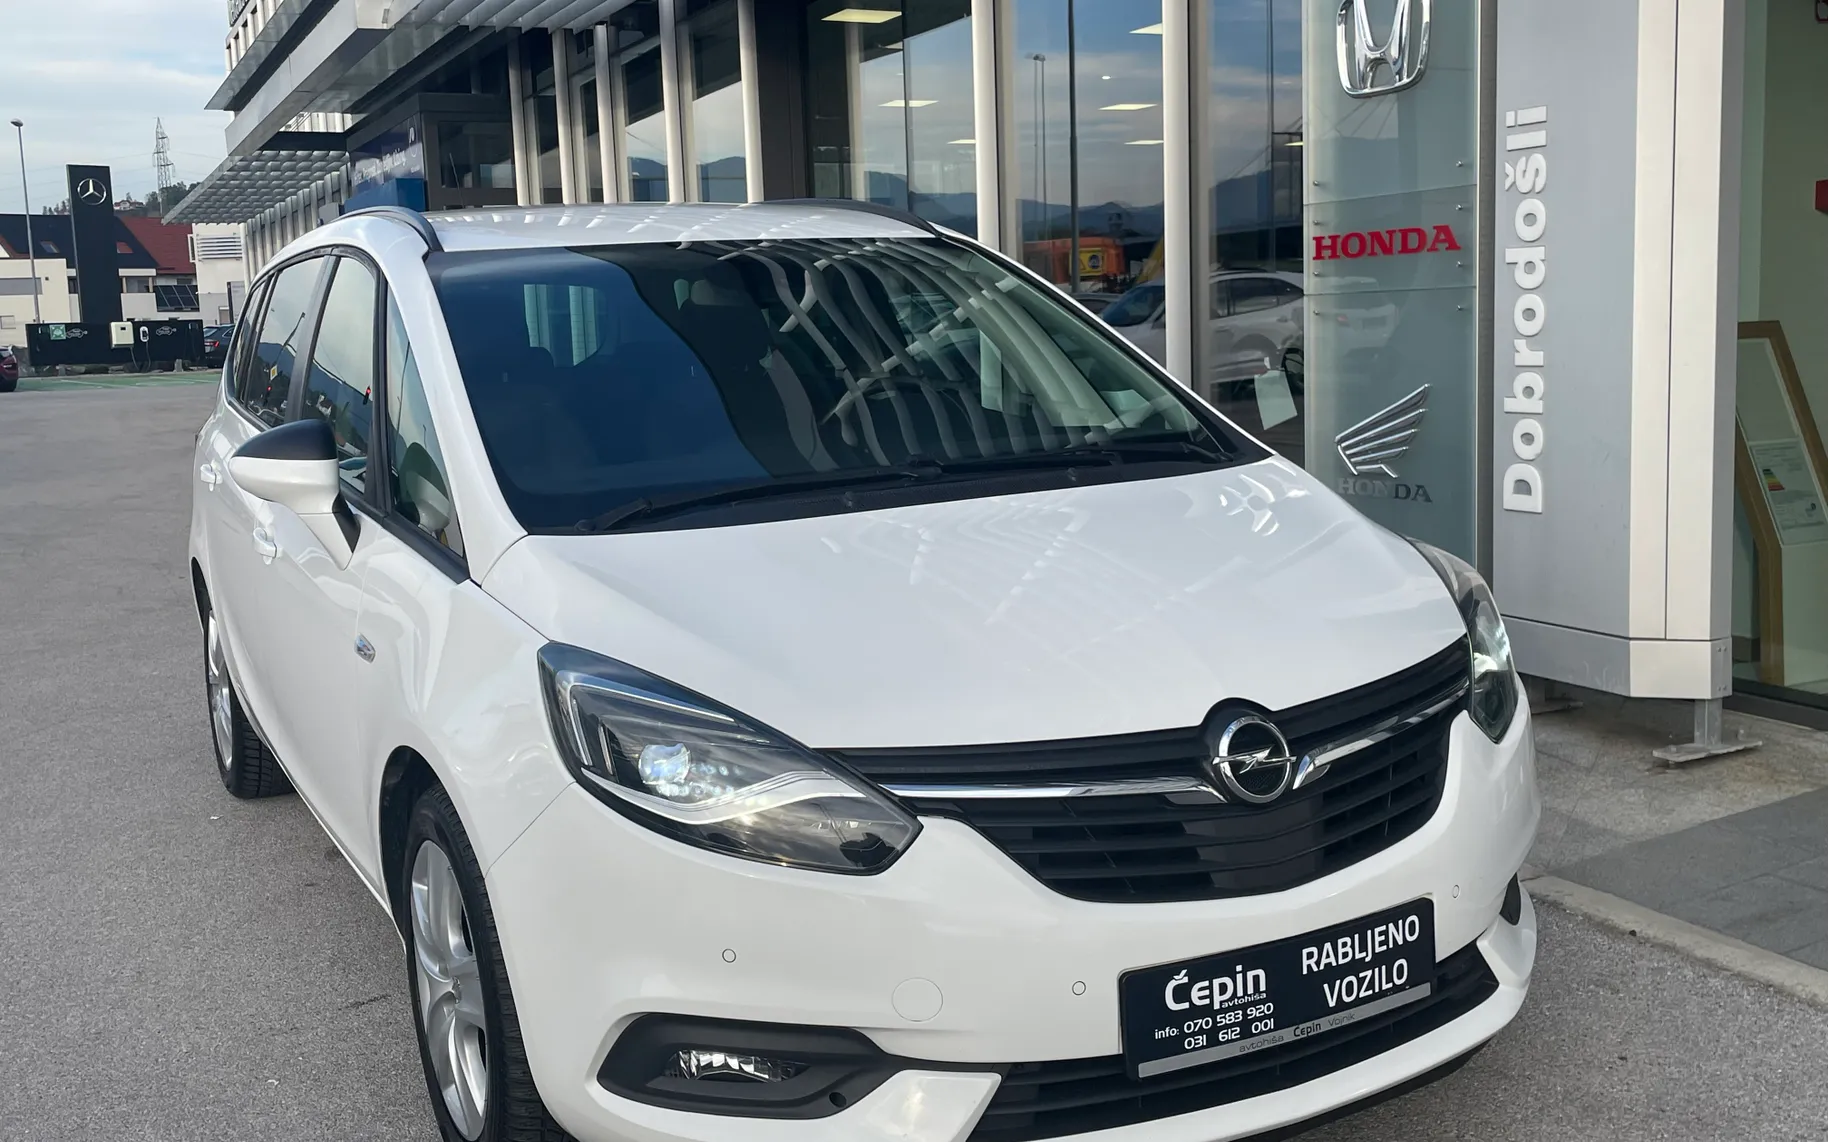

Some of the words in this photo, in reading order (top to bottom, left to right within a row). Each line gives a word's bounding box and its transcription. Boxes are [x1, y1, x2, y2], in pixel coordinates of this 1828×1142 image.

[1313, 225, 1461, 261] HONDA
[1503, 105, 1548, 514] Dobrodošli
[1338, 478, 1433, 503] HONDA
[1302, 914, 1420, 975] RABLJENO
[1165, 965, 1267, 1010] Čepin
[1221, 992, 1267, 1009] avtohiša
[1323, 959, 1408, 1008] VOZILO
[1154, 1027, 1180, 1040] info:
[1184, 1017, 1212, 1034] 070
[1216, 1010, 1243, 1026] 583
[1247, 1003, 1274, 1019] 920
[1184, 1035, 1207, 1049] 031
[1218, 1027, 1240, 1042] 612
[1251, 1019, 1274, 1034] 001
[1239, 1036, 1284, 1053] avtohiša
[1293, 1021, 1322, 1038] Čepin
[1328, 1012, 1355, 1027] Vojnik
